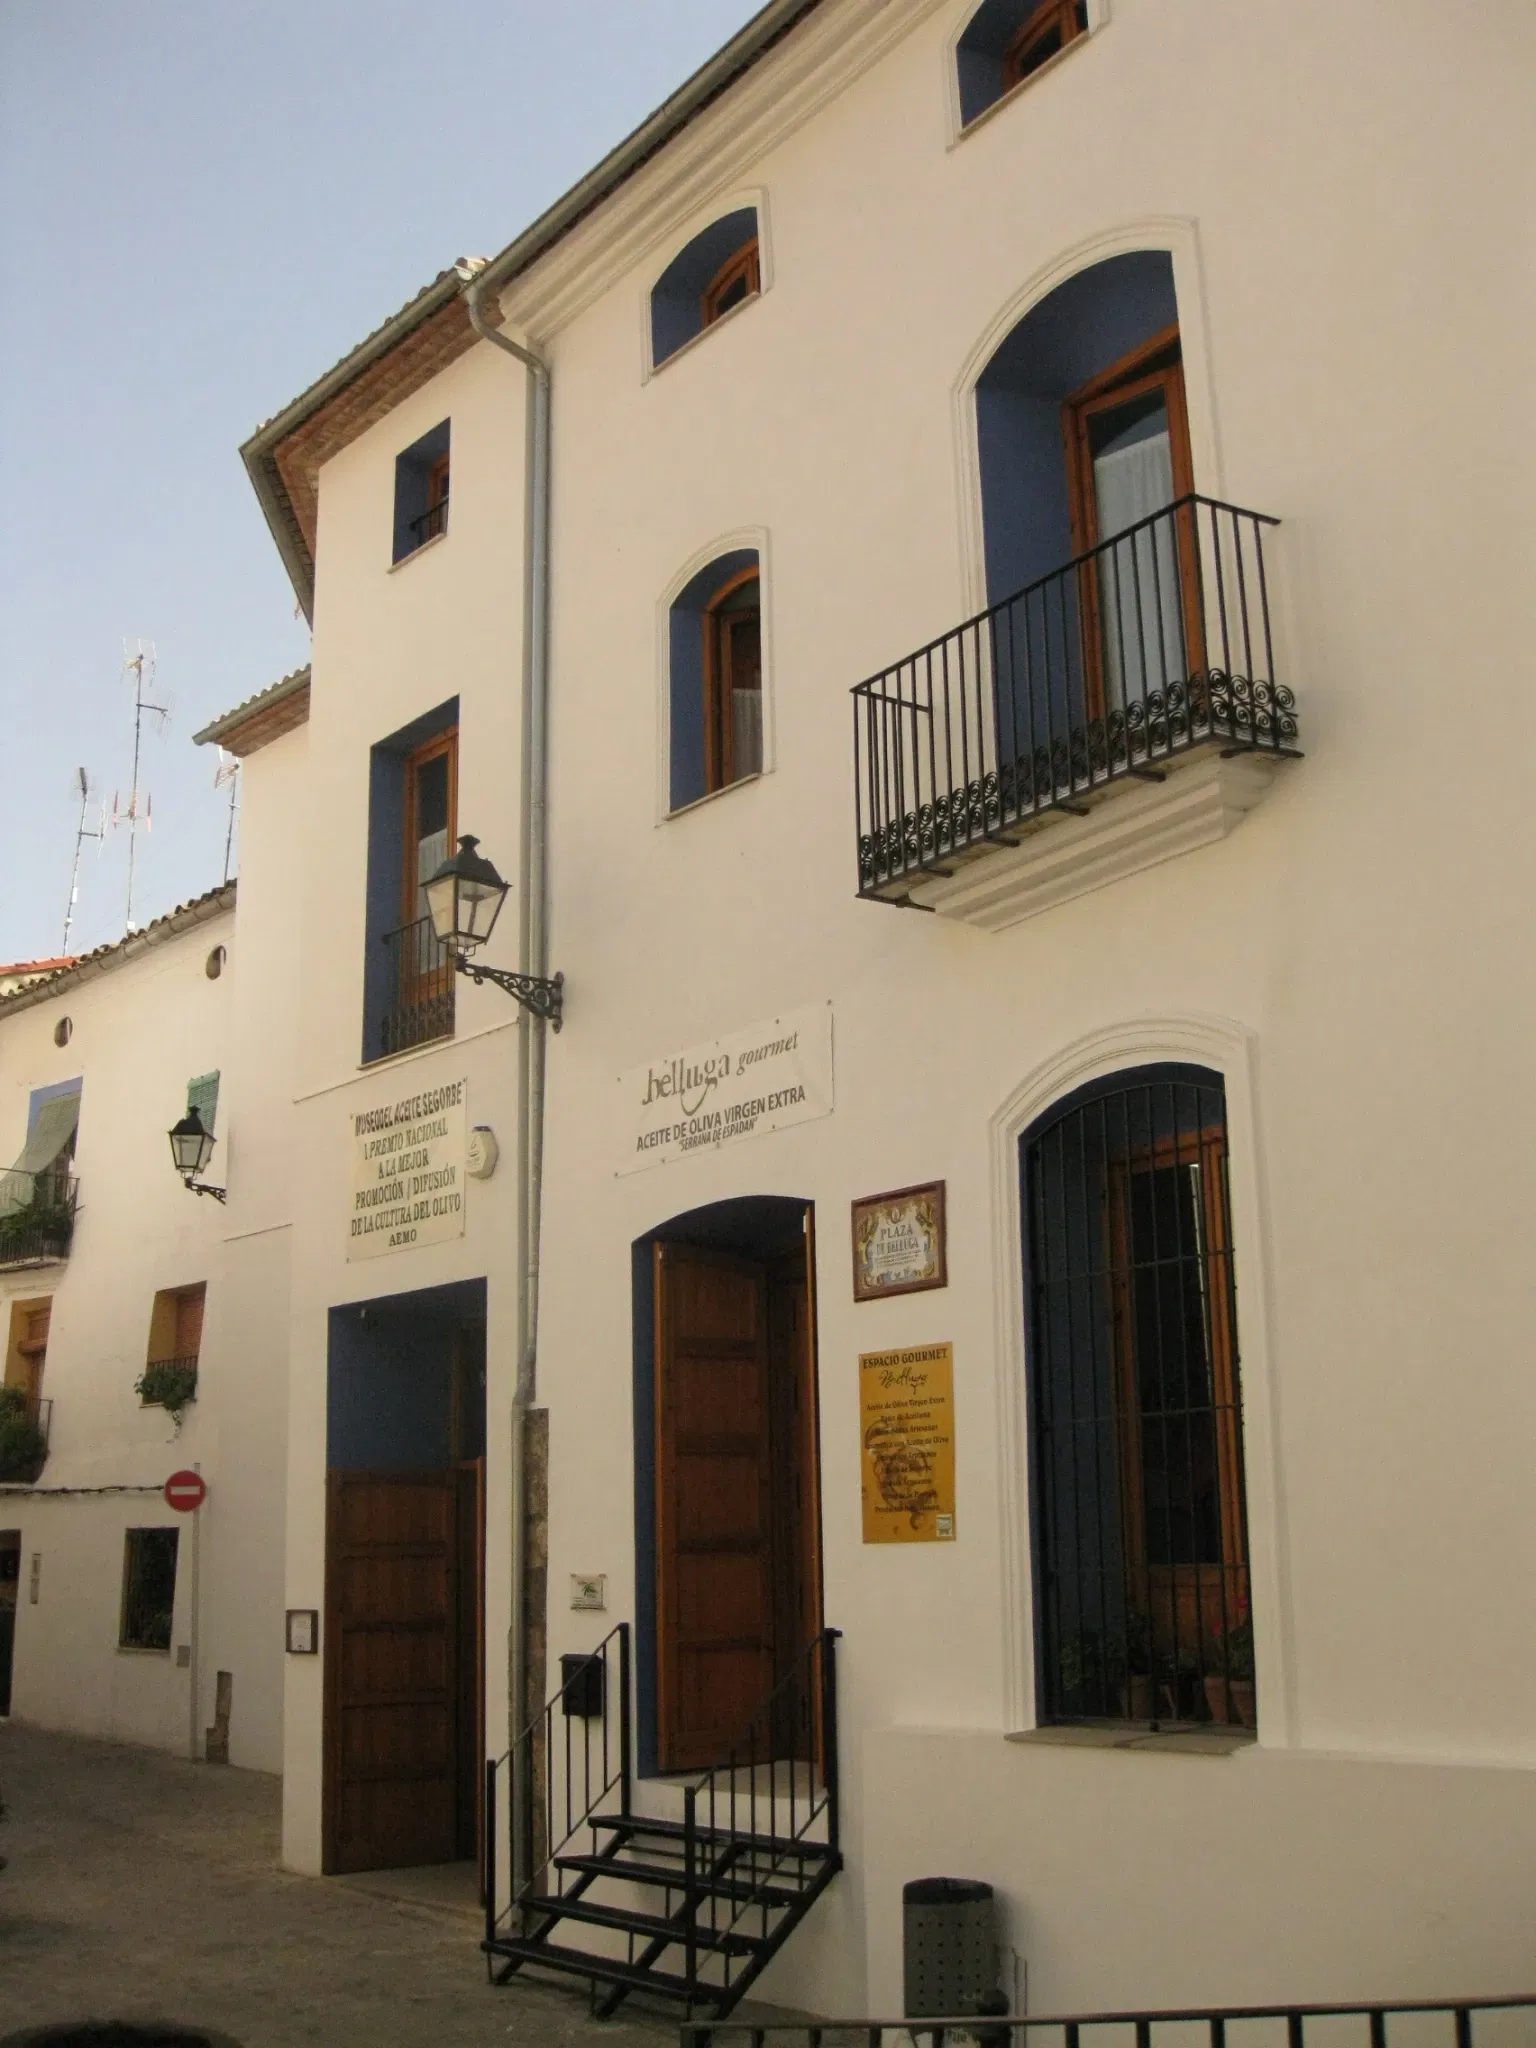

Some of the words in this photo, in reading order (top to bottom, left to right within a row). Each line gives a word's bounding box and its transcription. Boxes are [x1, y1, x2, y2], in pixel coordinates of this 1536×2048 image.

[736, 1030, 800, 1076] gourmet
[394, 1094, 422, 1125] ACEITE
[422, 1081, 462, 1116] SEGORBE
[636, 1127, 671, 1152] ACEITE
[673, 1121, 687, 1140] DE
[689, 1111, 722, 1135] OLIVA
[724, 1098, 766, 1124] VIRGEN
[768, 1085, 806, 1111] EXTRA
[370, 1132, 404, 1159] PREMIO
[405, 1117, 449, 1148] NACIONAL
[712, 1127, 722, 1143] DE
[378, 1161, 385, 1180] A
[386, 1157, 397, 1178] LA
[398, 1147, 430, 1174] MEJOR
[355, 1177, 404, 1211] PROMOCIÓN
[413, 1161, 456, 1196] DIFUSIÓN
[351, 1217, 362, 1237] DE
[364, 1214, 374, 1234] LA
[375, 1204, 412, 1231] CULTURA
[413, 1200, 431, 1222] DEL
[433, 1192, 461, 1217] OLIVO
[880, 1223, 913, 1241] PLAZA
[388, 1228, 418, 1248] AEMO
[863, 1353, 900, 1370] ESPACIO
[901, 1347, 948, 1364] GOURMET
